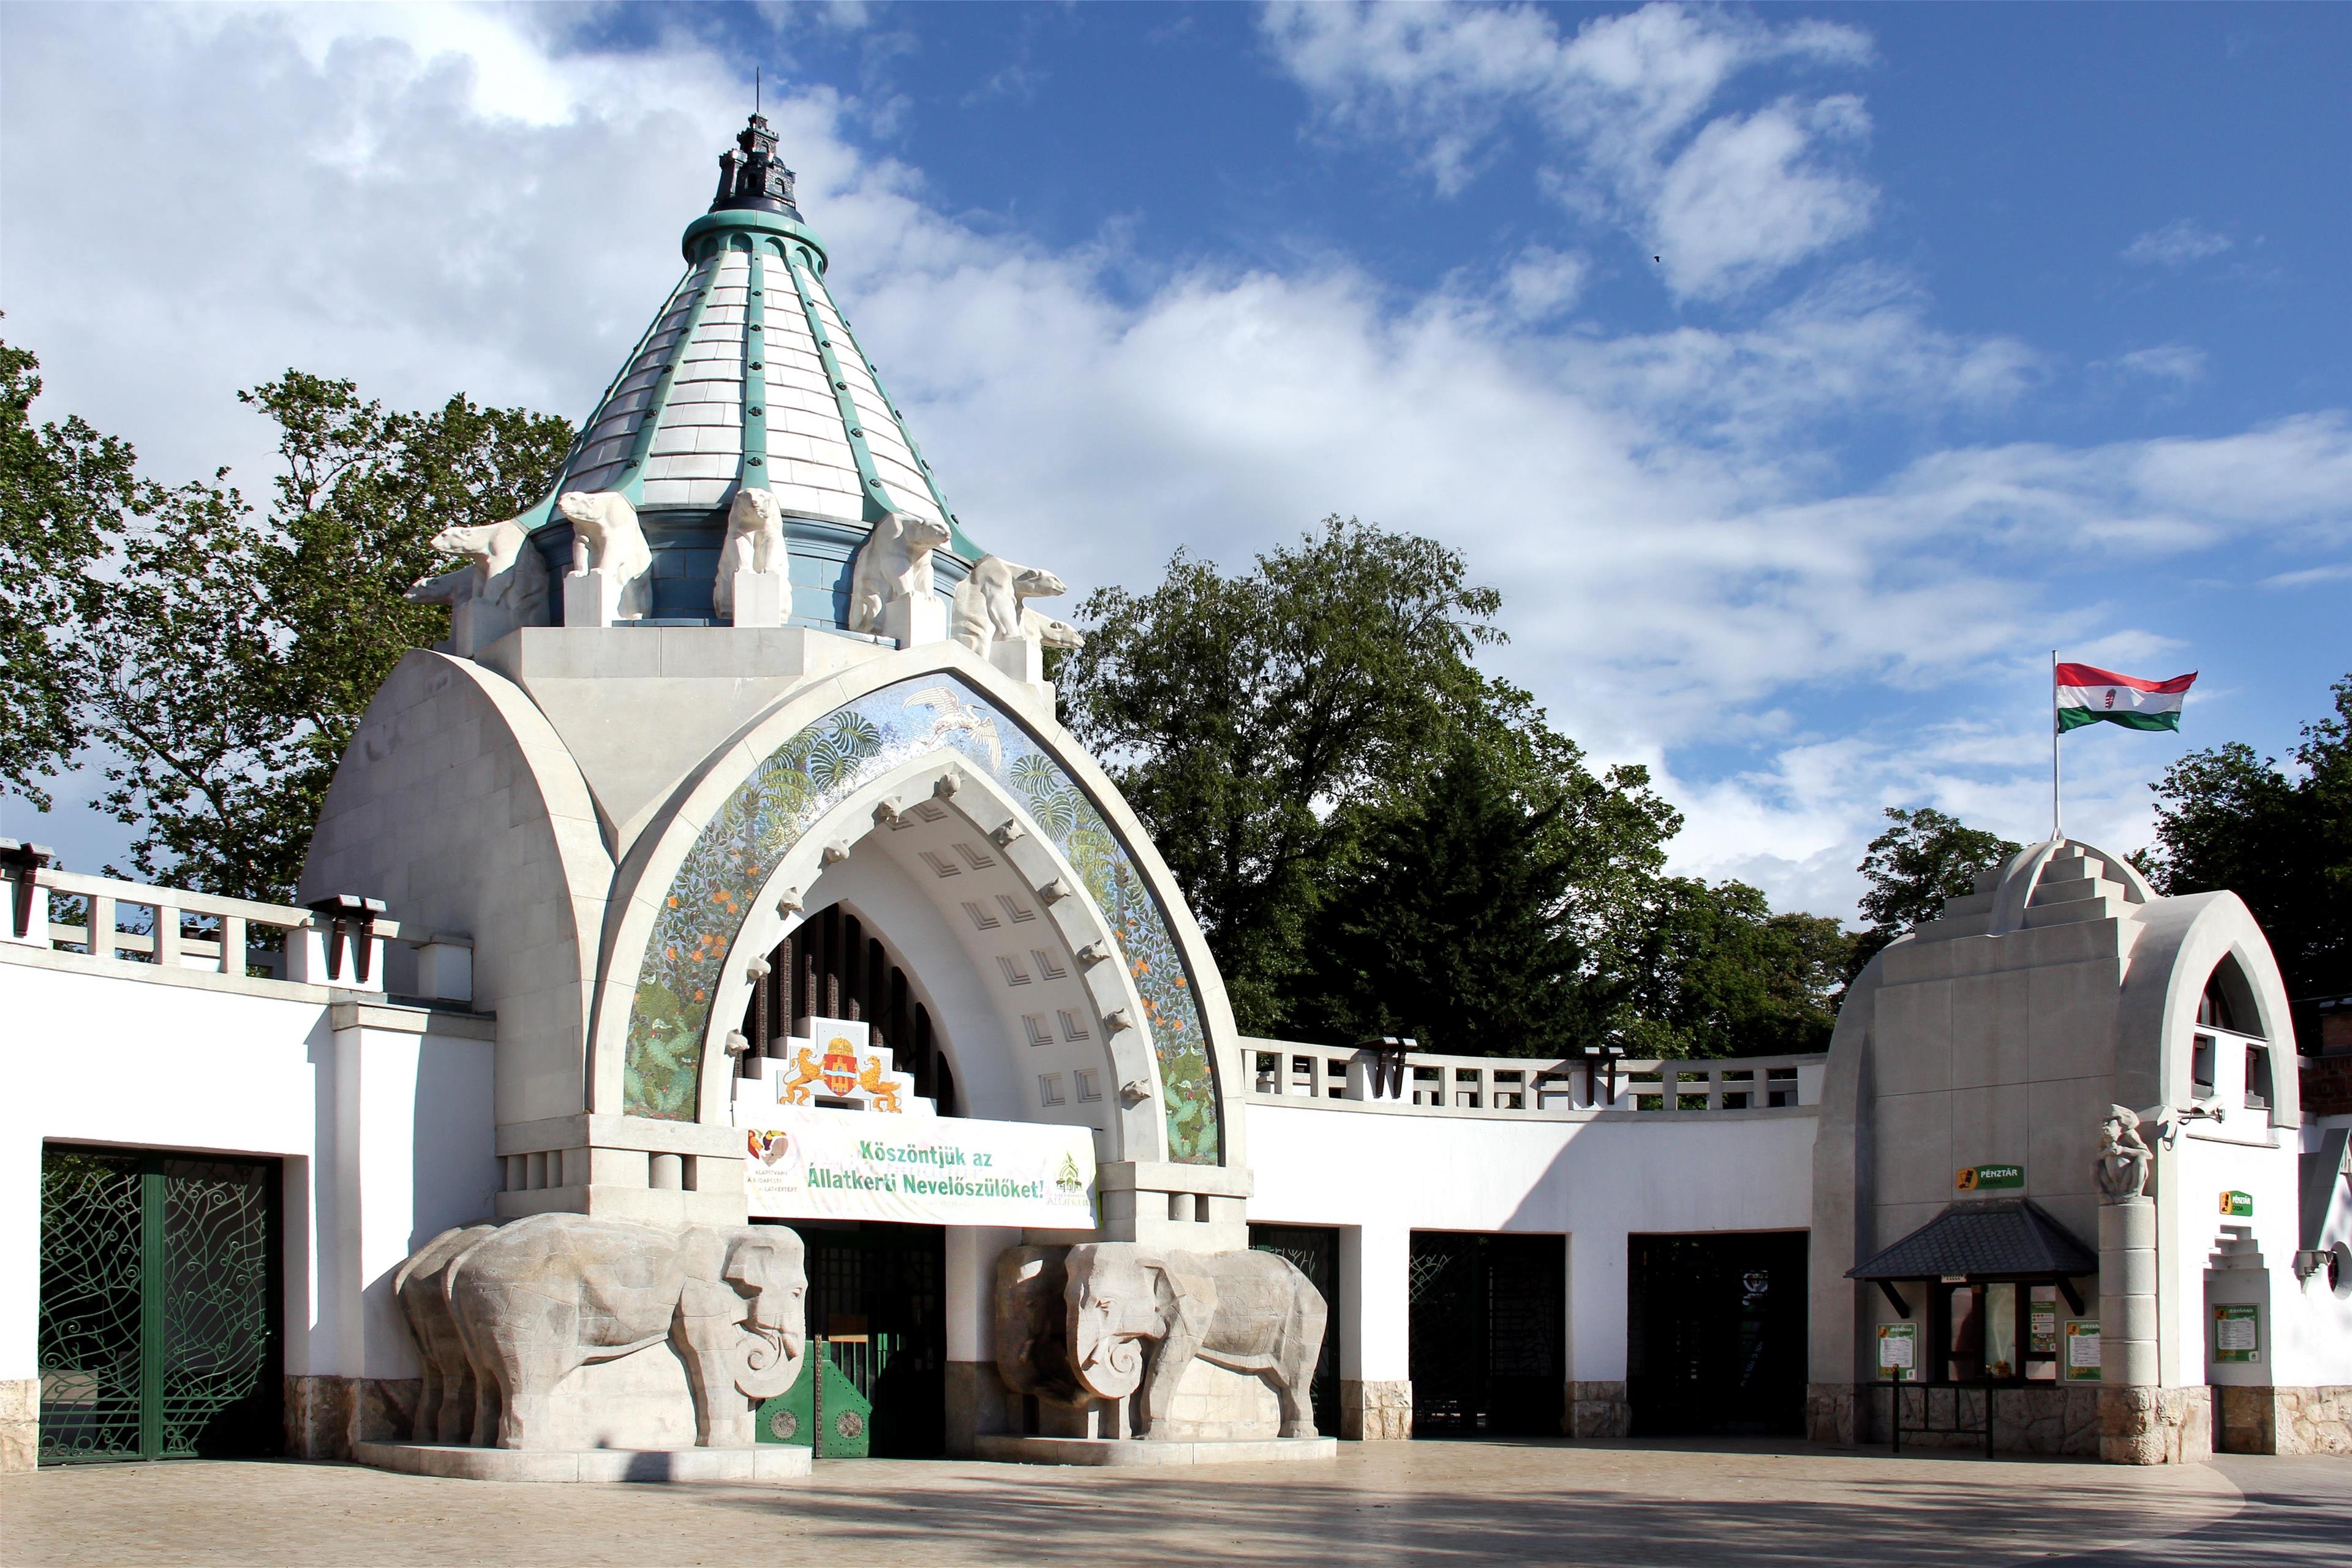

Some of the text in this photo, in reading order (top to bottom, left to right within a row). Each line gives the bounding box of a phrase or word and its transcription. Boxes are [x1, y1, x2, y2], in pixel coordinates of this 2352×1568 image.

[860, 1140, 992, 1169] Köszöntjük az
[807, 1162, 897, 1192] Állatkerti
[903, 1174, 1044, 1199] Nevelőszülőket!
[1981, 1168, 2018, 1178] PÉNZTÁR
[2232, 1194, 2252, 1205] PÉNZTÁR
